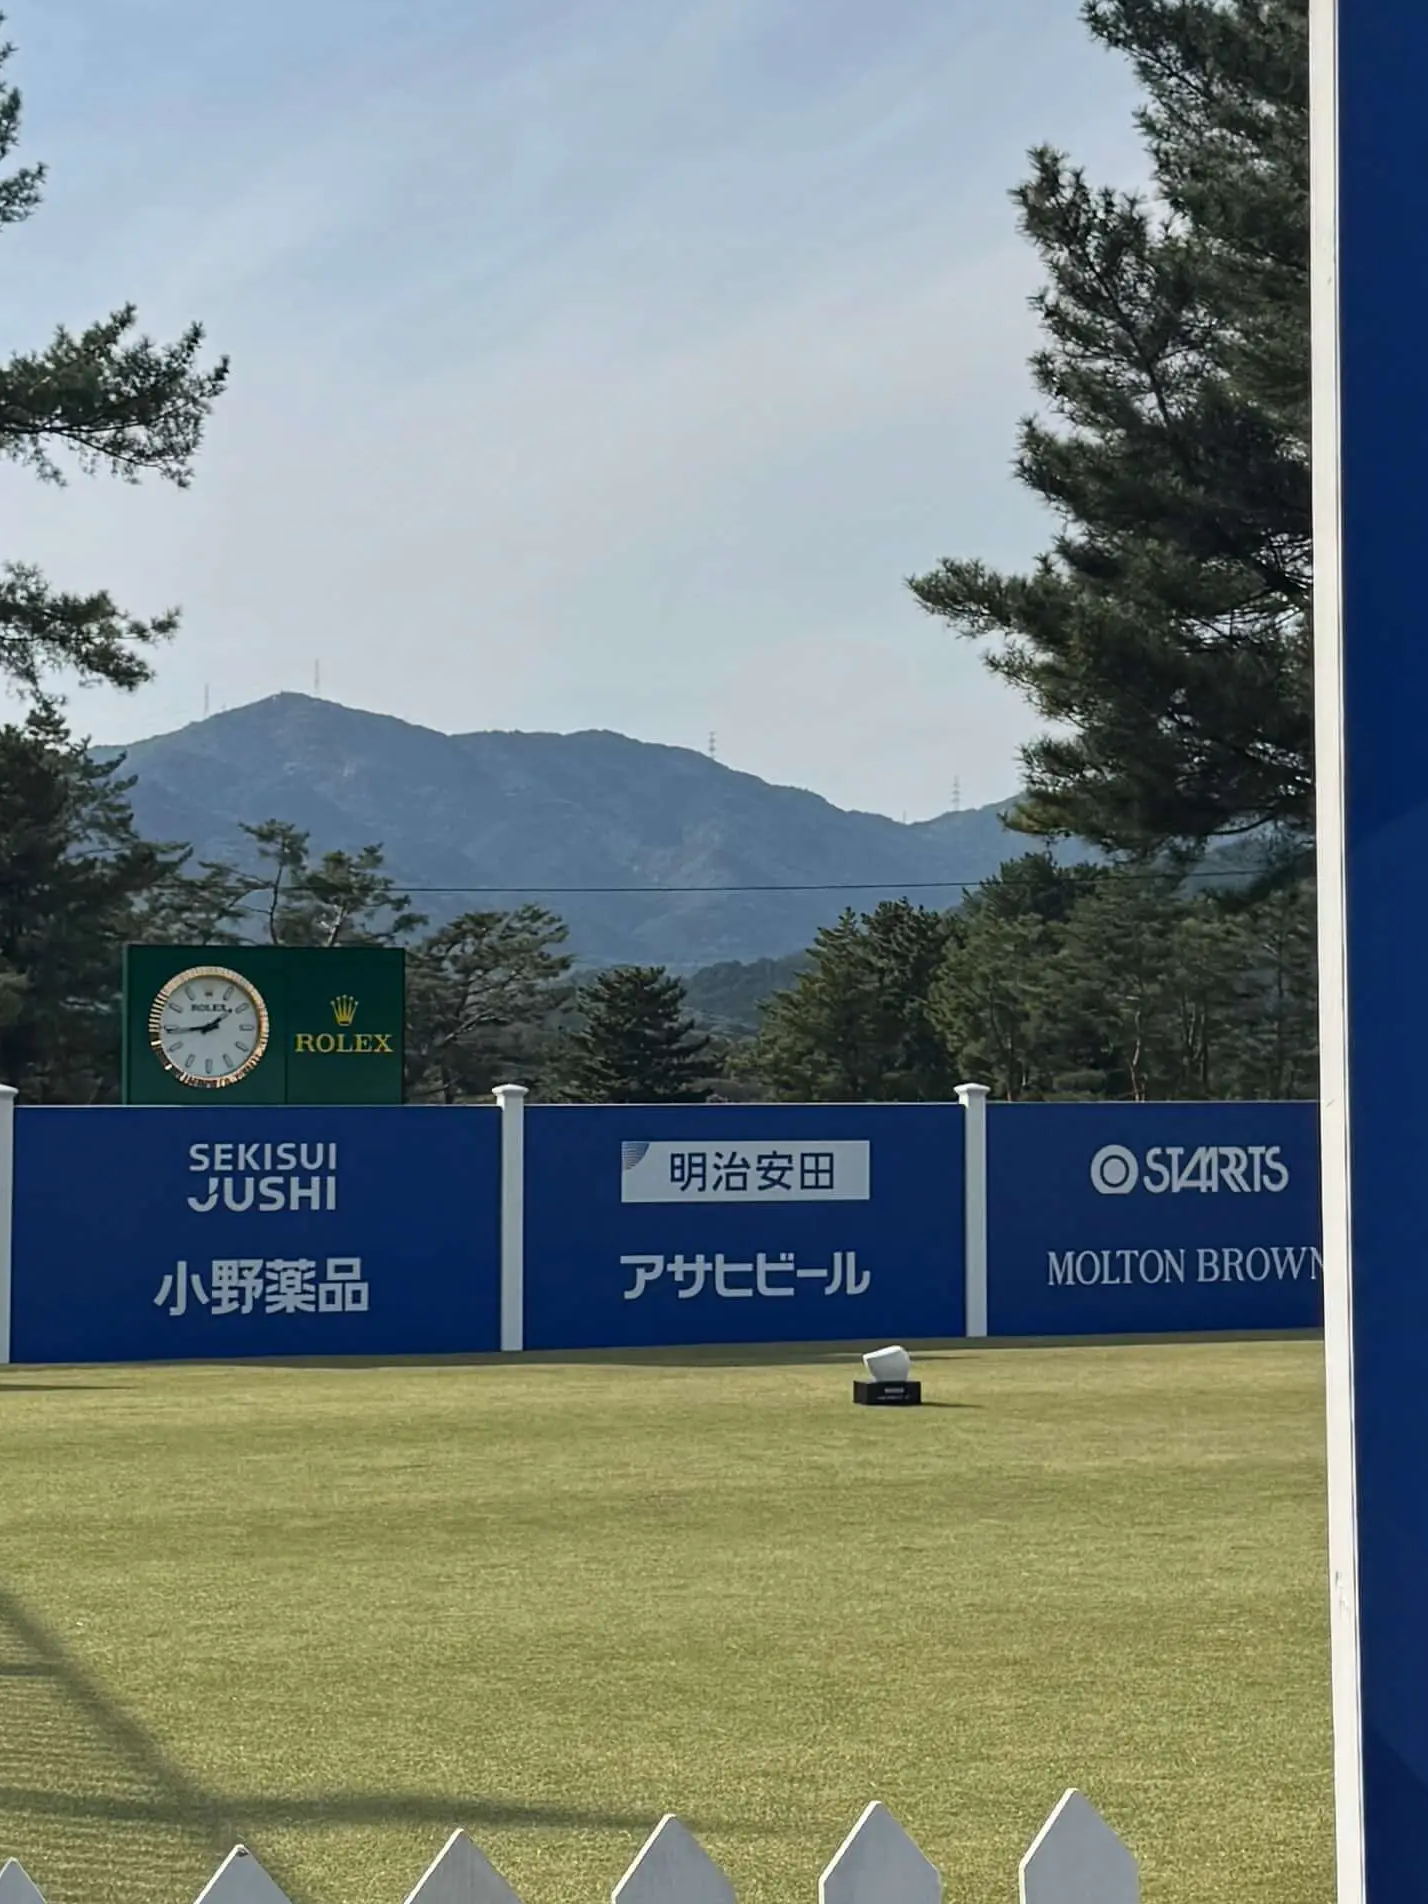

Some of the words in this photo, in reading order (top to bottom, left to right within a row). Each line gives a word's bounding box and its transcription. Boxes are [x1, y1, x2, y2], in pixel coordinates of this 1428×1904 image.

[191, 1003, 227, 1012] ROLEX
[295, 1033, 393, 1052] ROLEX
[189, 1143, 337, 1171] SEKISUI
[670, 1151, 834, 1191] 明治安田
[187, 1176, 337, 1212] JUSHI
[620, 1252, 871, 1299] アサヒビール
[1047, 1249, 1186, 1285] MOLTON
[154, 1257, 369, 1315] 小野薬品
